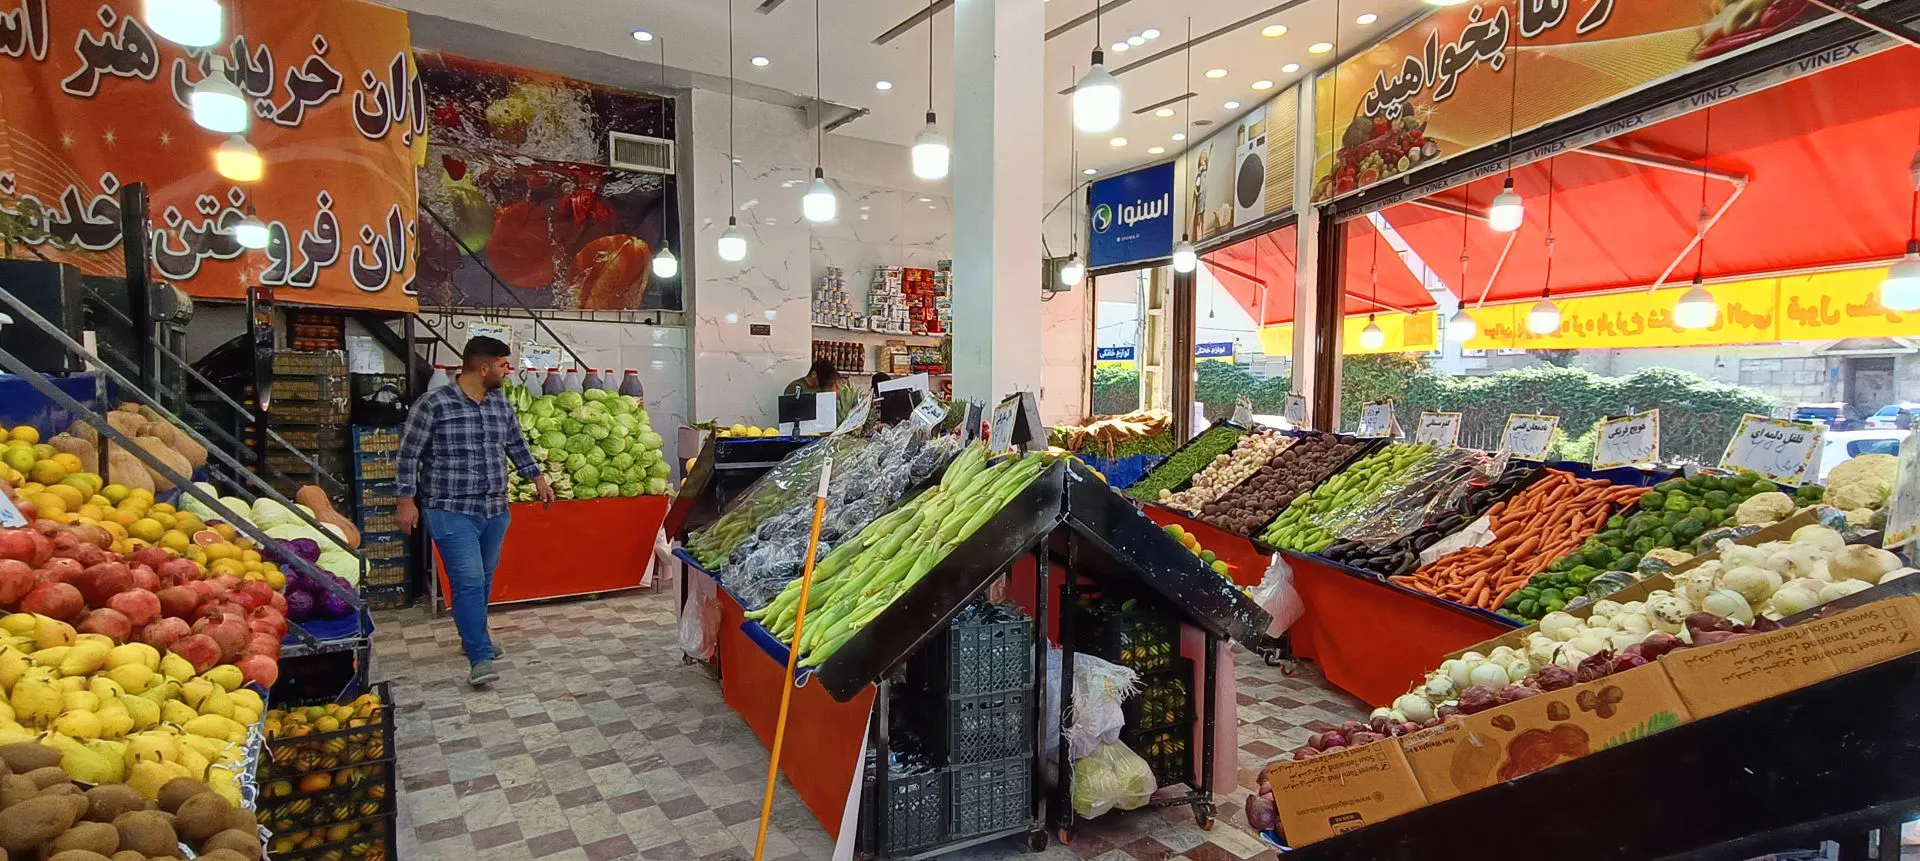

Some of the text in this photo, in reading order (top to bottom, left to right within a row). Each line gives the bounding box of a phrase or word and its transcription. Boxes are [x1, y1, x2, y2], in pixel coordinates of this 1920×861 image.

[0, 0, 48, 62] اس
[61, 4, 160, 97] هنر
[1799, 42, 1861, 73] VINEX
[1364, 4, 1509, 120] بخواهید
[1690, 82, 1740, 107] VINEX
[1604, 115, 1645, 135] VINEX
[1533, 141, 1567, 158] VINEX
[1474, 162, 1504, 177] VINEX
[1425, 180, 1449, 193] VINEX
[1117, 192, 1169, 227] اسنوا
[152, 186, 342, 288] فروختن
[1608, 423, 1646, 439] هویج فرنگی
[1751, 428, 1804, 444] فلفل دلمه ای
[1829, 619, 1839, 629] &
[1839, 609, 1878, 628] Sweet
[1801, 622, 1829, 637] Sour
[1856, 622, 1888, 638] Sour
[1748, 629, 1801, 651] Tamarind
[1802, 630, 1856, 652] Tamarind
[1857, 634, 1895, 652] Sweet
[1775, 644, 1800, 659] ترش
[1801, 644, 1857, 666] Tamarind
[1763, 658, 1797, 675] شیرین
[1419, 740, 1442, 751] Weight
[1442, 737, 1455, 746] Net
[1350, 745, 1371, 756] Sweet
[1298, 755, 1328, 769] Tamarind
[1327, 758, 1359, 772] Tamarind
[1358, 754, 1375, 764] Sour
[1358, 764, 1379, 775] Sweet
